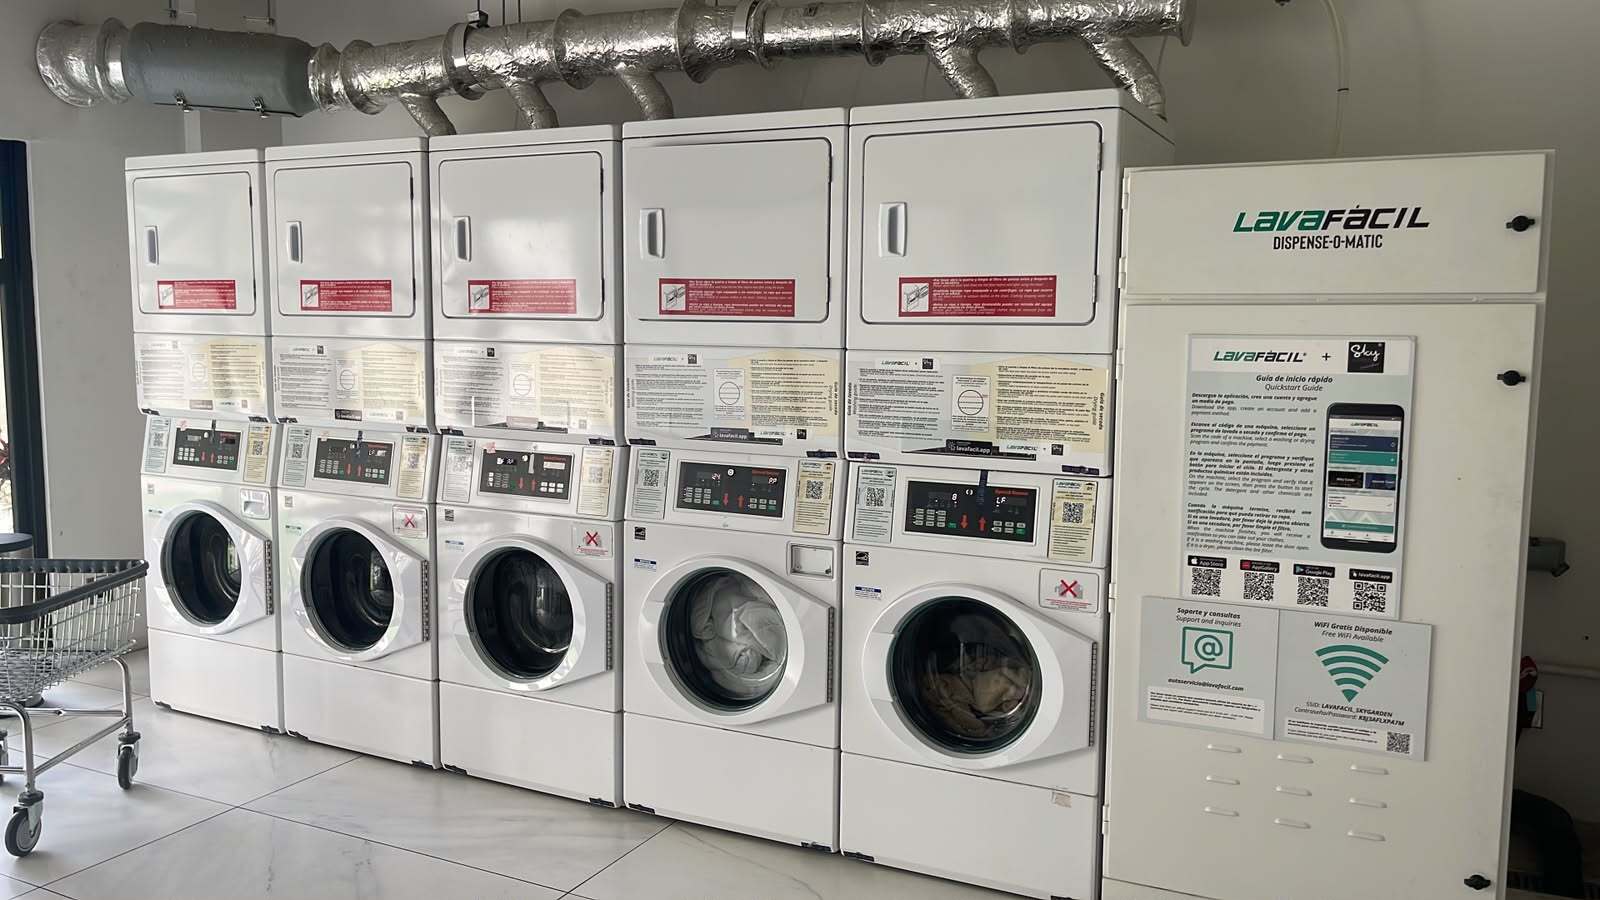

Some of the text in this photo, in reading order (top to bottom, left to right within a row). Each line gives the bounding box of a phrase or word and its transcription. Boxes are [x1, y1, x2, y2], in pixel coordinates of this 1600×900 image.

[1273, 234, 1383, 250] DISPENSE-O-MATIC
[1286, 375, 1307, 383] inicio
[1308, 376, 1333, 385] rápido
[1265, 384, 1301, 392] Quickstart
[1177, 607, 1202, 616] Soporte
[1209, 610, 1240, 619] consultas
[1354, 625, 1392, 635] Disponible
[1353, 634, 1384, 642] Available
